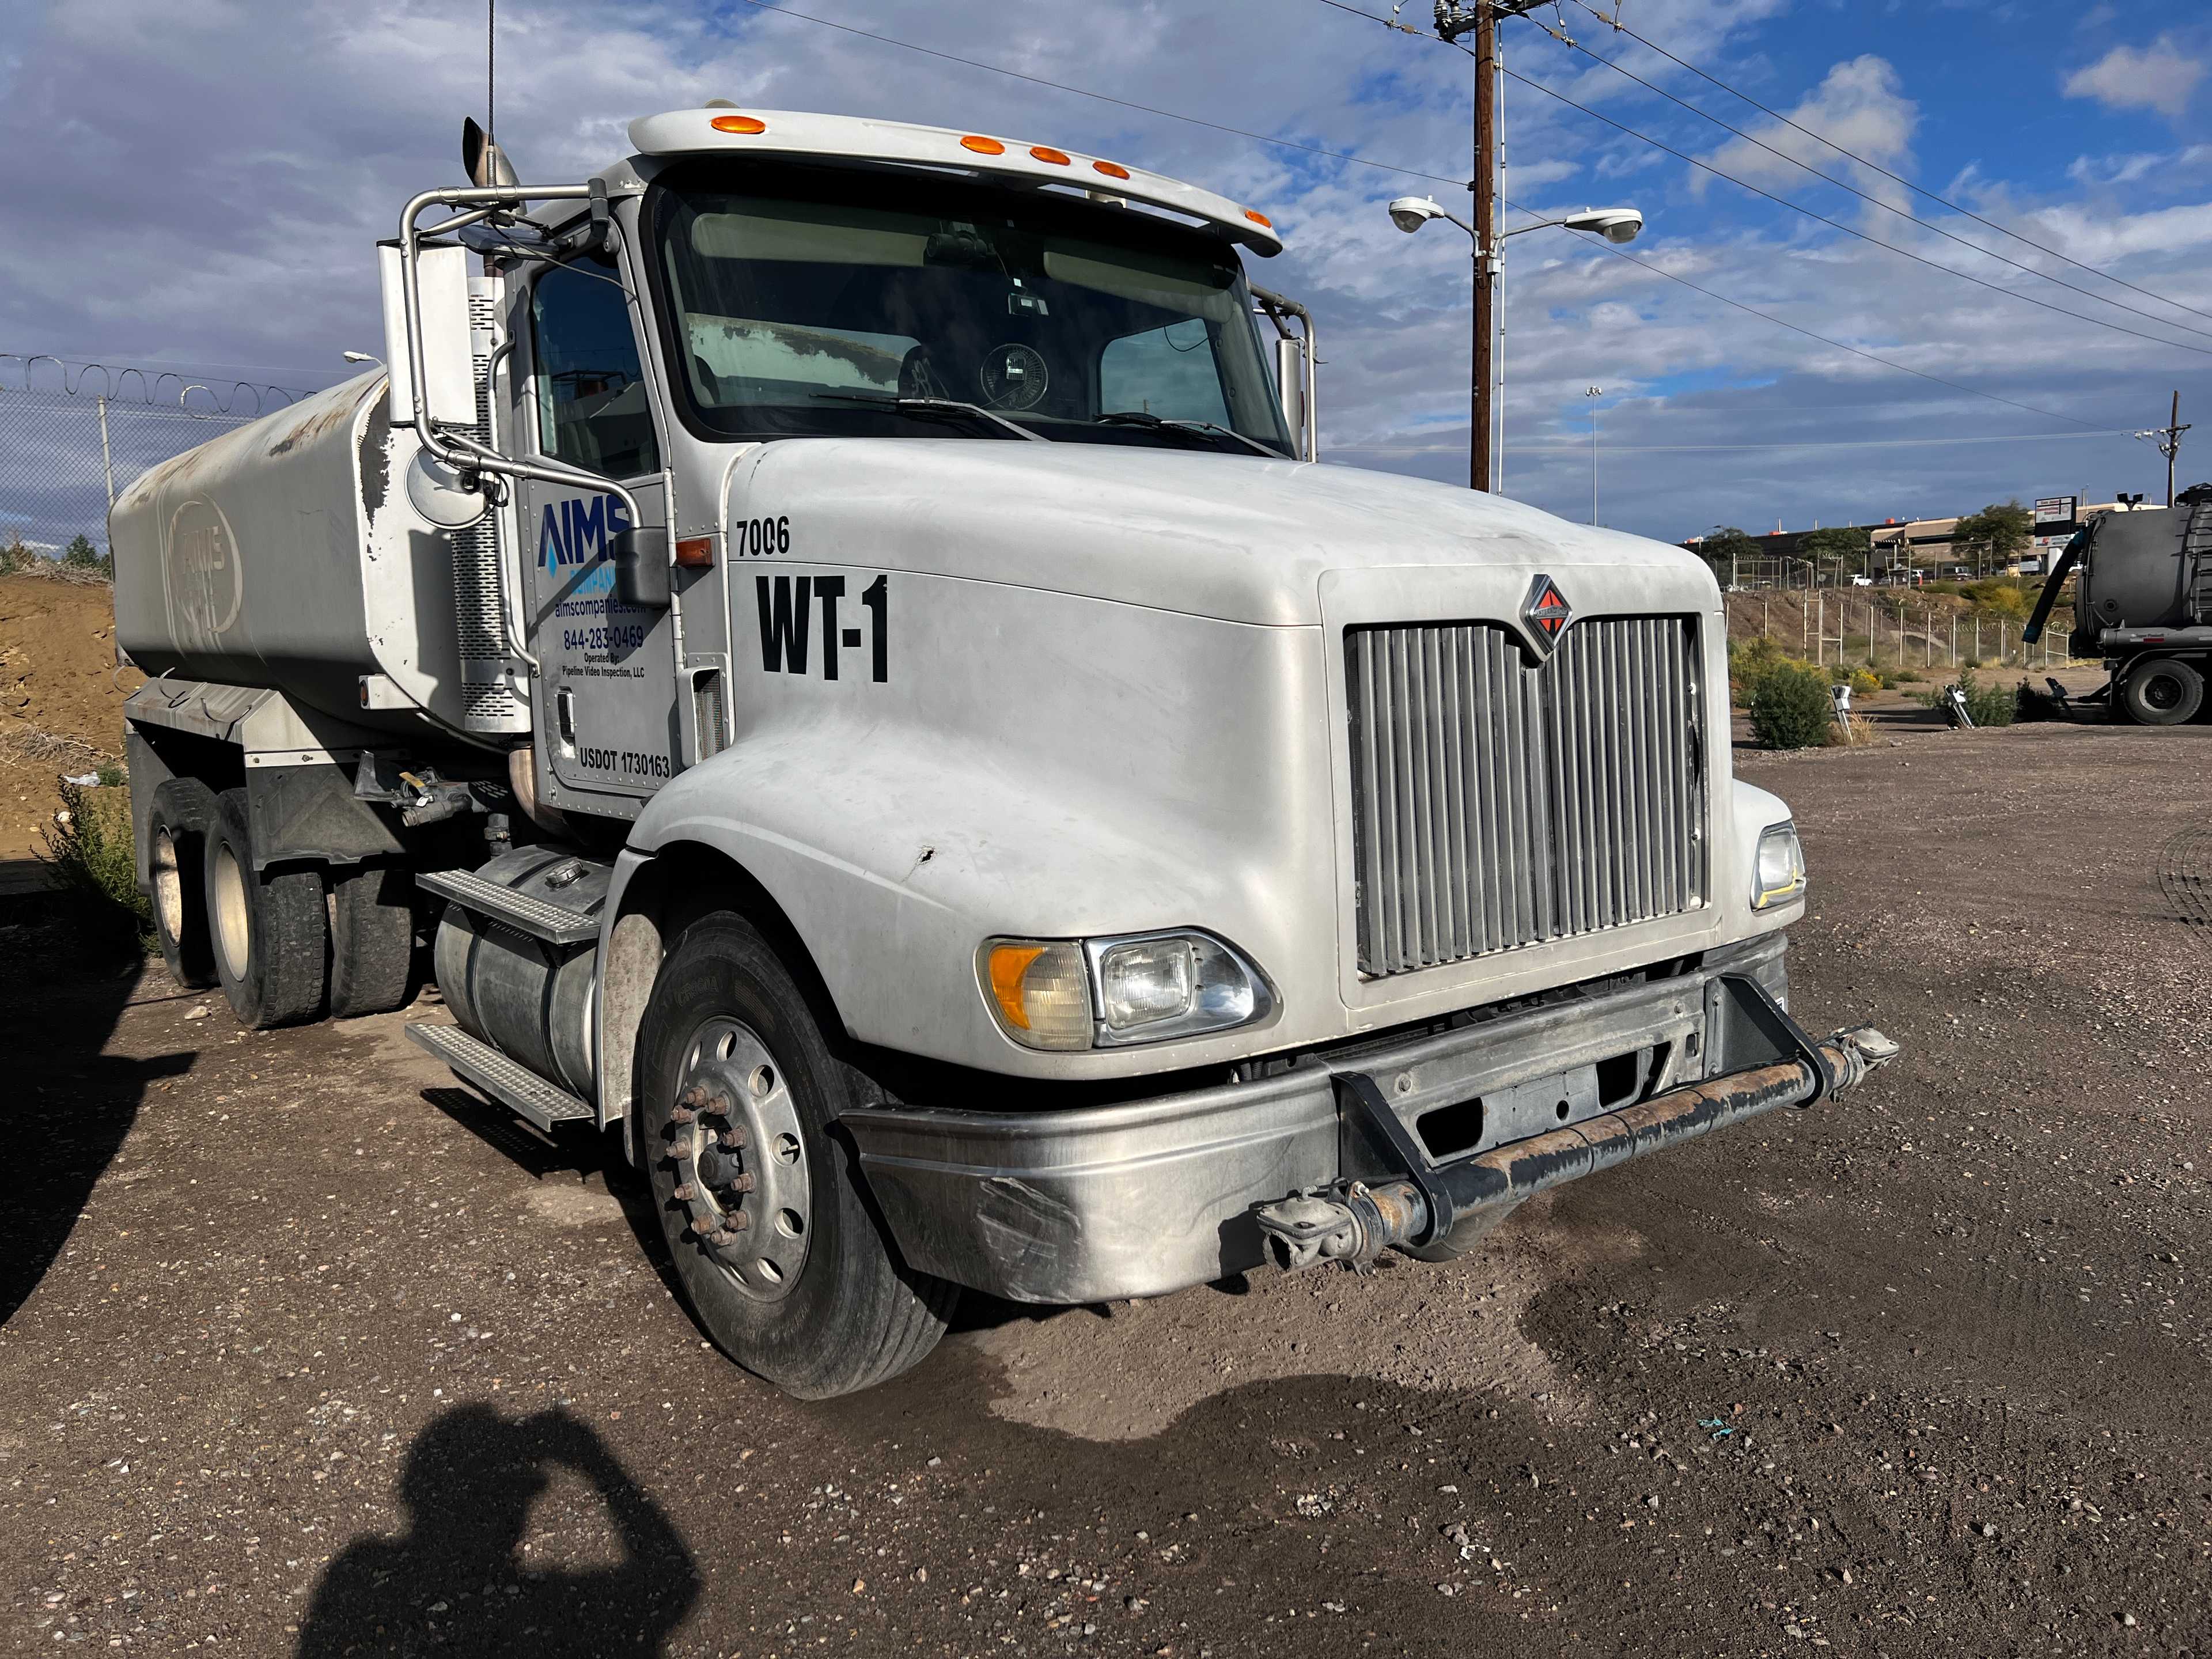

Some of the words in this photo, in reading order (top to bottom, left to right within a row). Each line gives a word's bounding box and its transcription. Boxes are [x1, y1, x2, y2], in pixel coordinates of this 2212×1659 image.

[736, 516, 790, 557] 7006
[564, 625, 643, 650] 844-283-0469
[755, 574, 888, 683] WT-1
[562, 665, 584, 678] Pipeline
[584, 666, 600, 677] Video
[601, 666, 632, 680] Inspection,
[633, 666, 645, 678] LLC
[584, 652, 609, 665] Operated
[610, 652, 619, 665] By:
[580, 747, 618, 771] USDOT
[622, 751, 670, 778] 1730163
